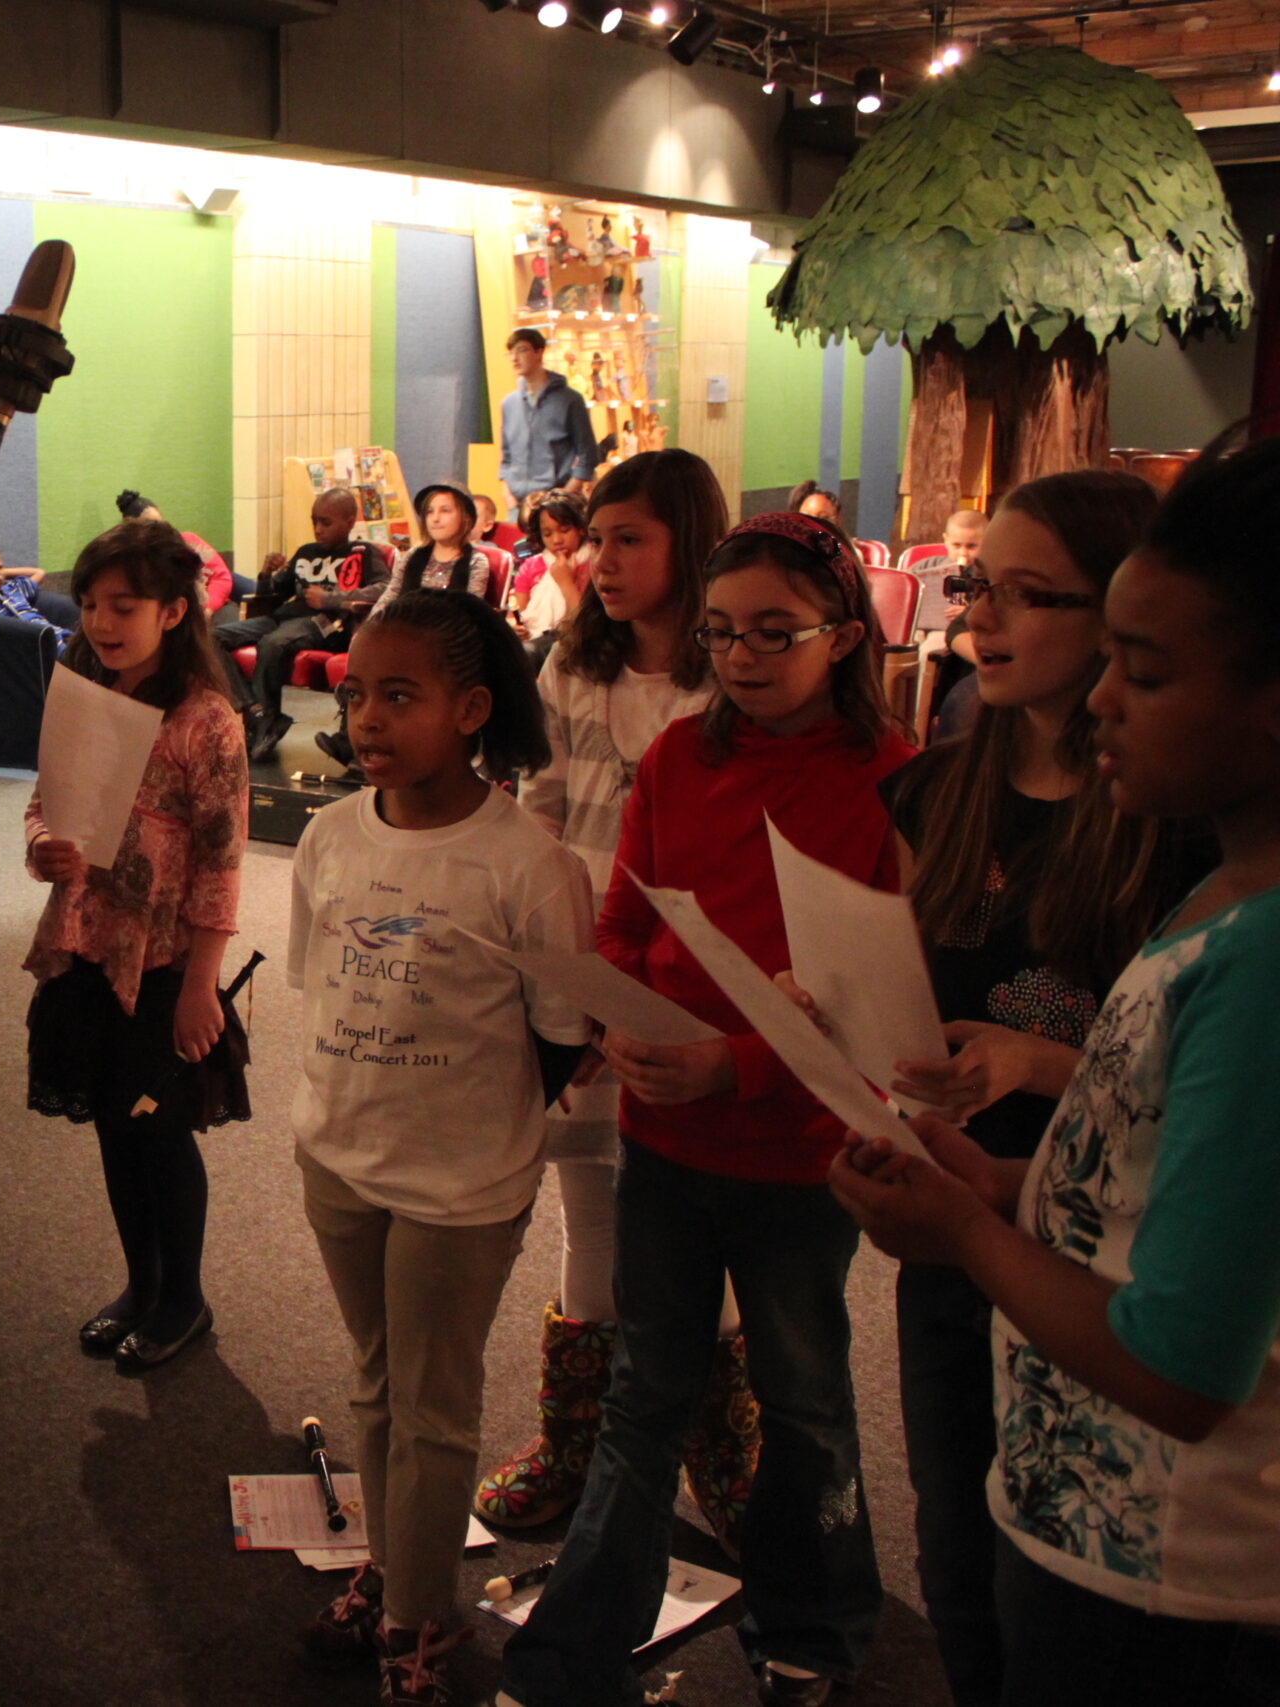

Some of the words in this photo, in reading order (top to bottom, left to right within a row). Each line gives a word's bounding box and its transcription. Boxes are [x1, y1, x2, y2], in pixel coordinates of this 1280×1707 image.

[340, 945, 420, 984] PEACE
[334, 1018, 376, 1046] Propel
[379, 1027, 417, 1047] East
[349, 1043, 408, 1066] Concert
[412, 1053, 449, 1067] 2011
